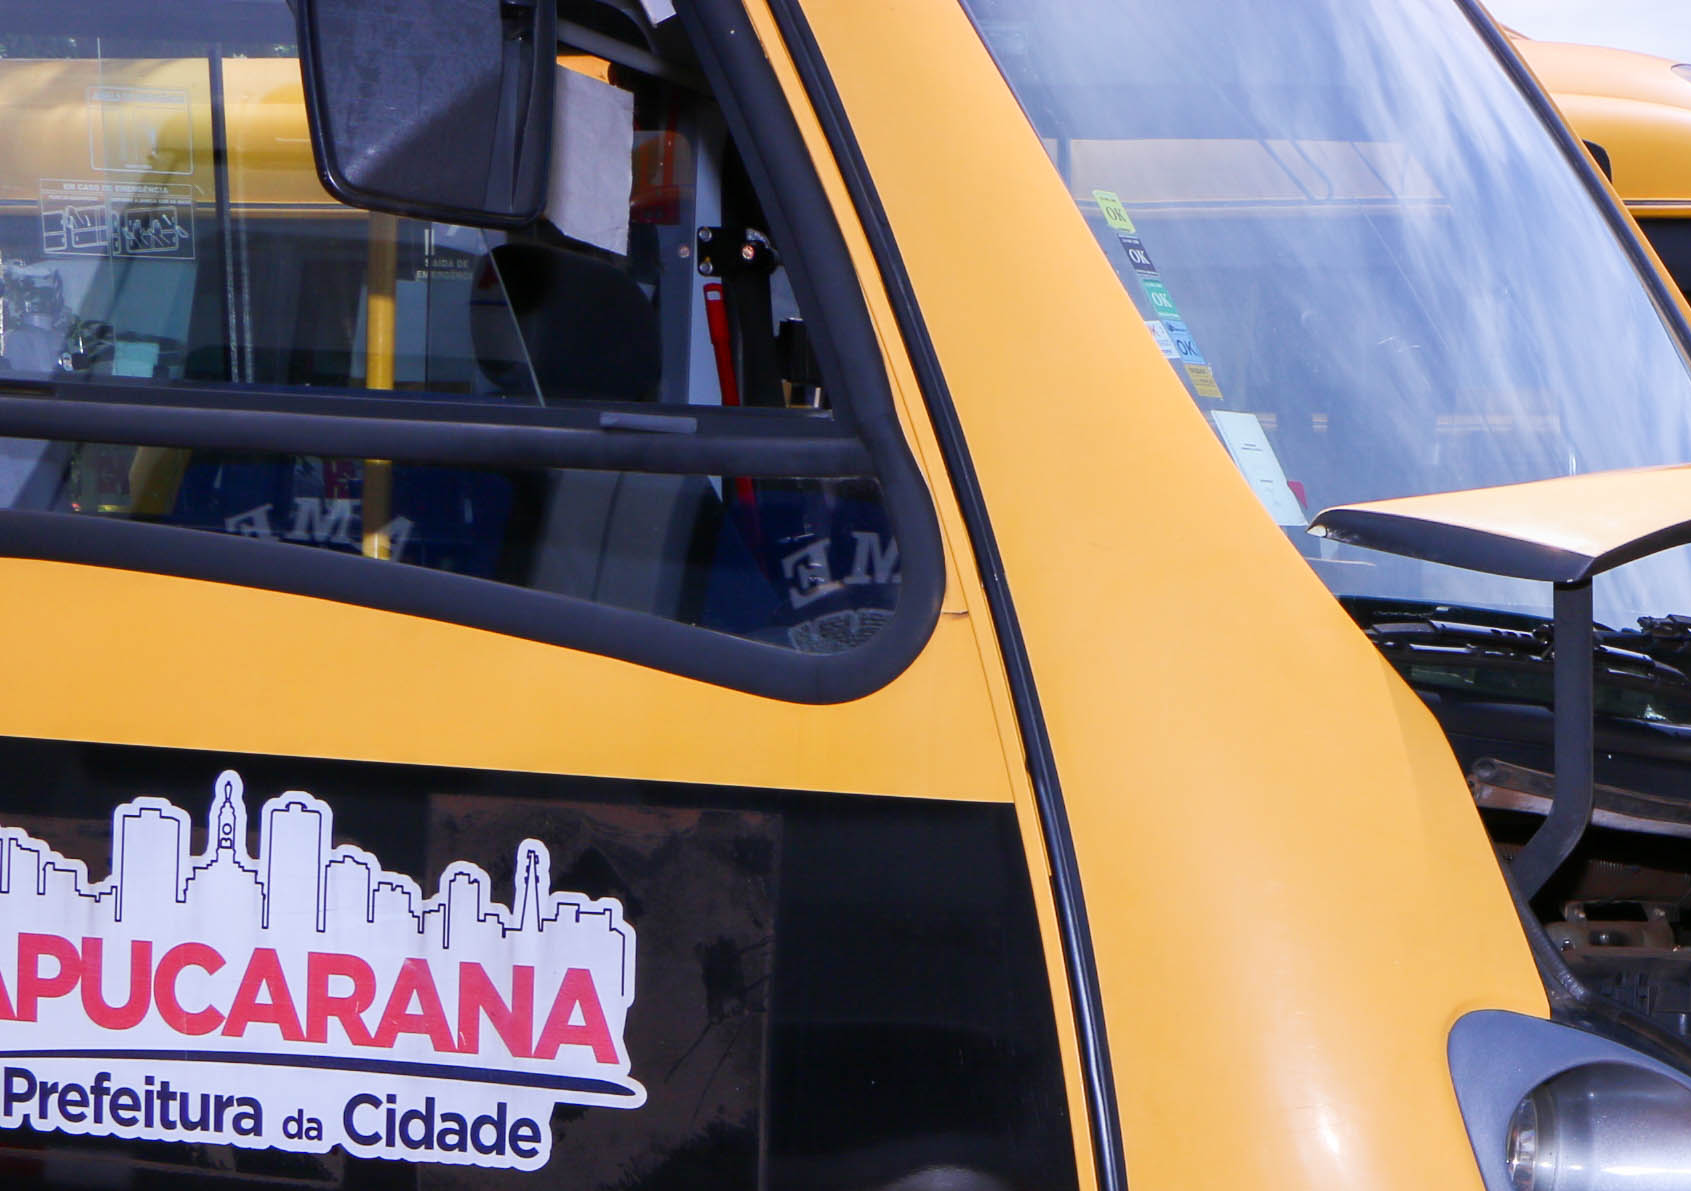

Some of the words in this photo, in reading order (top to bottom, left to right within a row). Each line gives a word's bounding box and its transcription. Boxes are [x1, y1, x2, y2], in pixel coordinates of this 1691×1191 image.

[1105, 206, 1127, 222] OK
[1128, 248, 1150, 265] OK
[1152, 292, 1173, 308] OK
[1176, 339, 1199, 356] OK
[4, 1066, 263, 1137] Prefeitura
[282, 1108, 323, 1141] da
[343, 1093, 541, 1159] Cidade
